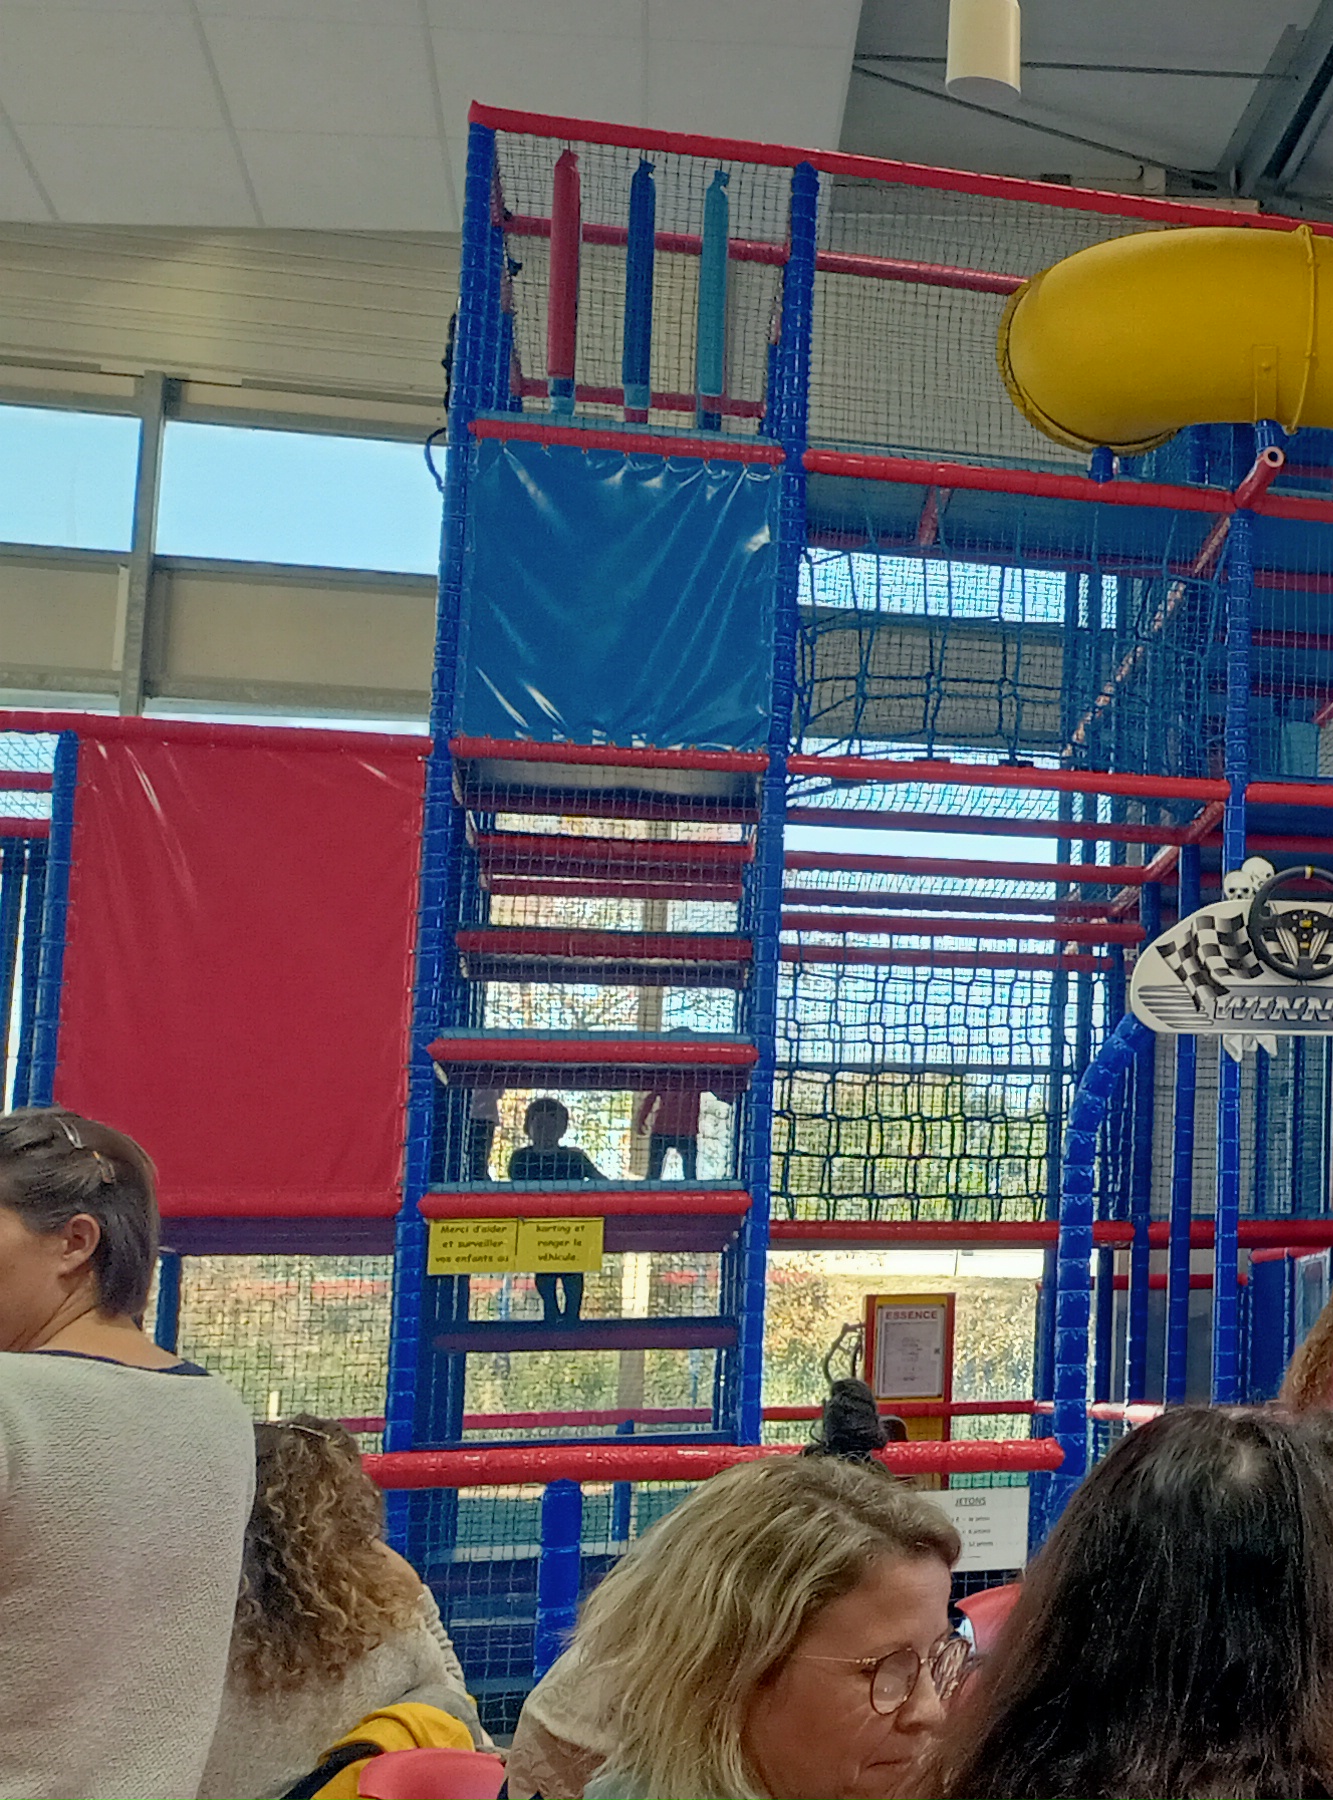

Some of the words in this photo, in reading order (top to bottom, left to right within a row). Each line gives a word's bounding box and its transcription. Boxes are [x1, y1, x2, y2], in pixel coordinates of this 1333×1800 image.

[441, 1225, 469, 1233] Merci
[442, 1240, 453, 1248] et
[574, 1238, 582, 1246] le
[455, 1253, 493, 1263] enfants
[885, 1310, 938, 1319] ESSENCE
